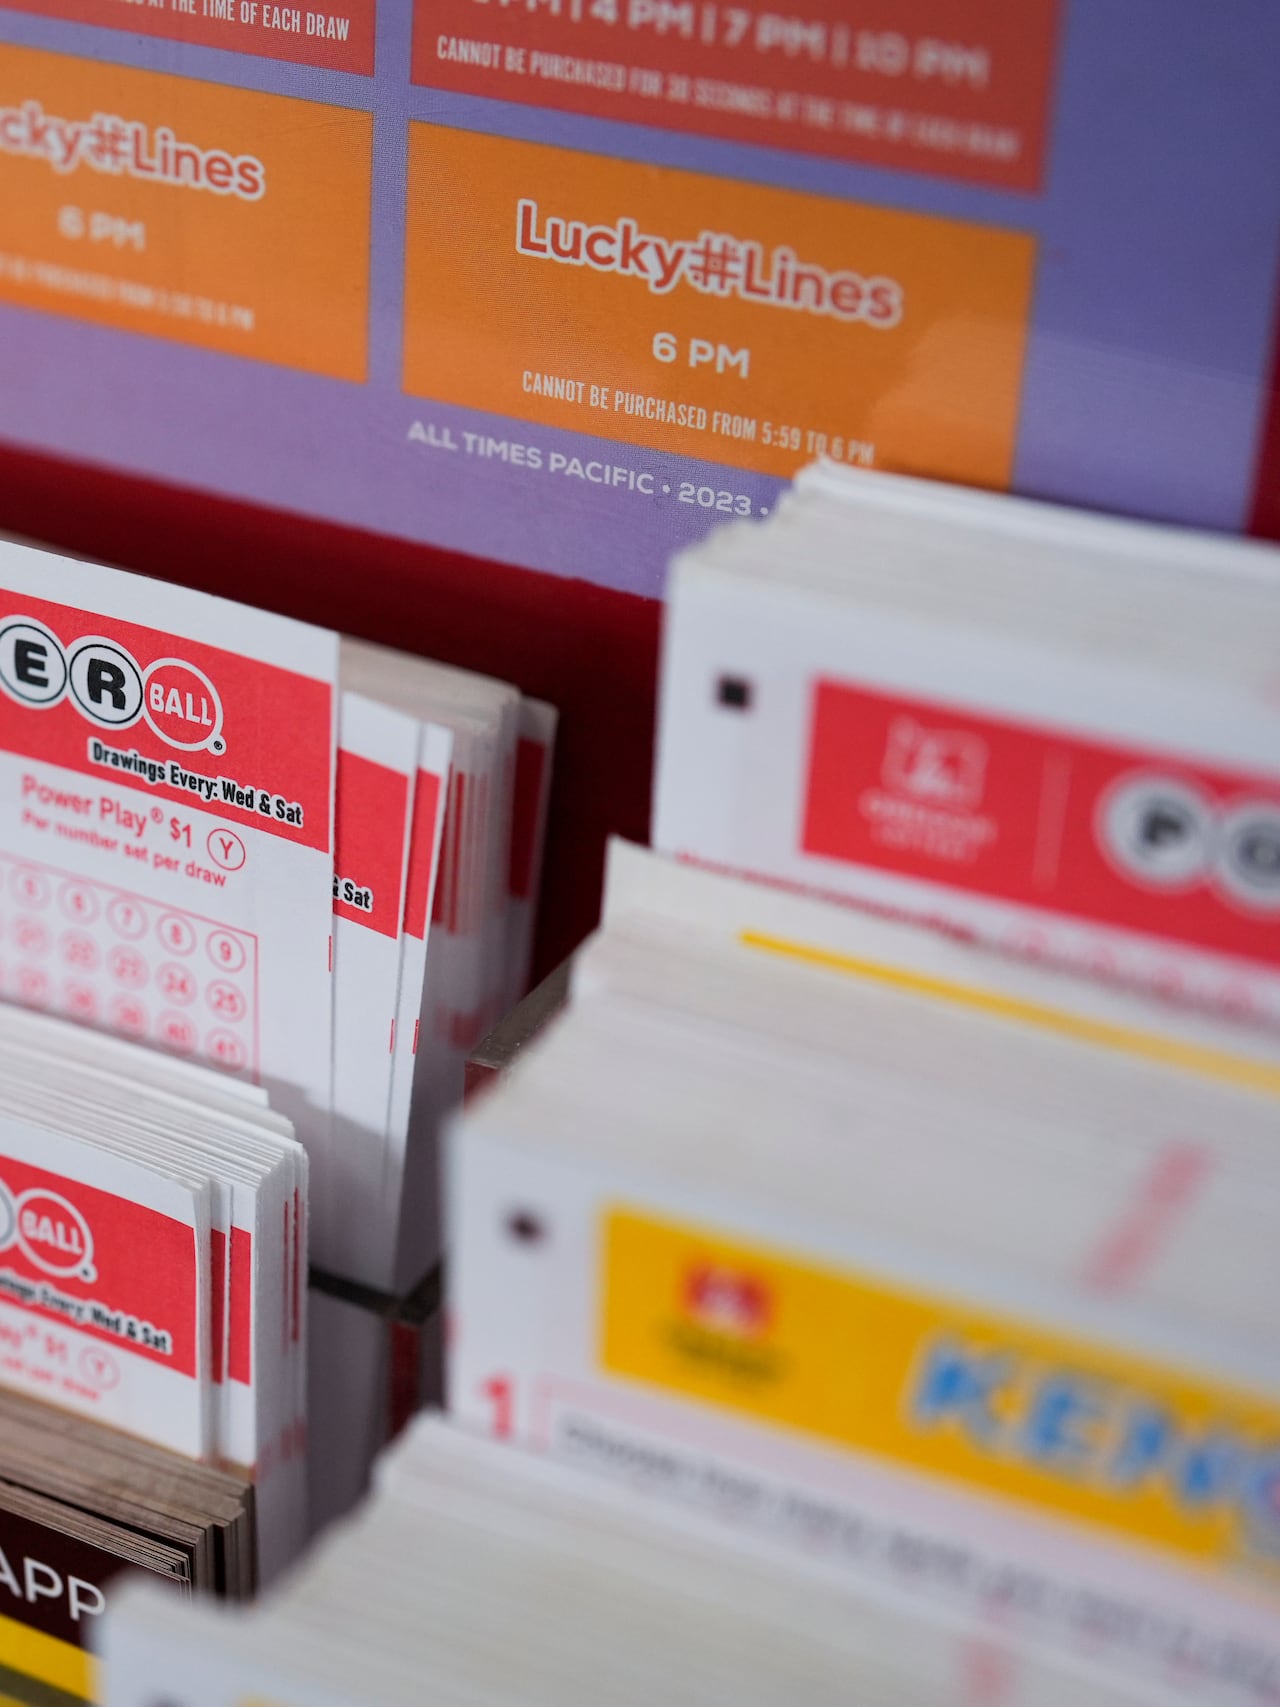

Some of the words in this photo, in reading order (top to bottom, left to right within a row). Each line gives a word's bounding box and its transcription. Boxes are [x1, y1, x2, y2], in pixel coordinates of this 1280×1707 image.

[203, 0, 235, 21] TIME
[240, 3, 257, 25] OF
[262, 5, 301, 33] EACH
[306, 13, 350, 41] DRAW
[437, 35, 502, 68] CANNOT
[505, 46, 526, 74] BE
[651, 332, 677, 363] 6
[689, 337, 749, 379] PM
[522, 371, 584, 397] CANNOT
[590, 384, 609, 410] BE
[614, 390, 707, 430] PURCHASED
[712, 411, 756, 441] FROM
[761, 422, 800, 452] 5:59
[847, 439, 875, 466] PM
[407, 421, 458, 450] ALL
[463, 432, 543, 470] TIMES
[549, 452, 654, 495] PACIFIC
[678, 481, 752, 516] 2023
[92, 742, 165, 782] Drawings
[170, 765, 218, 800] Every:
[222, 780, 254, 810] Wed
[260, 793, 271, 815] &
[276, 799, 303, 825] Sat
[23, 774, 93, 815] Power
[169, 817, 191, 848] $1
[219, 837, 234, 860] Y
[153, 851, 181, 871] per
[185, 861, 227, 887] draw
[343, 881, 370, 909] Sat
